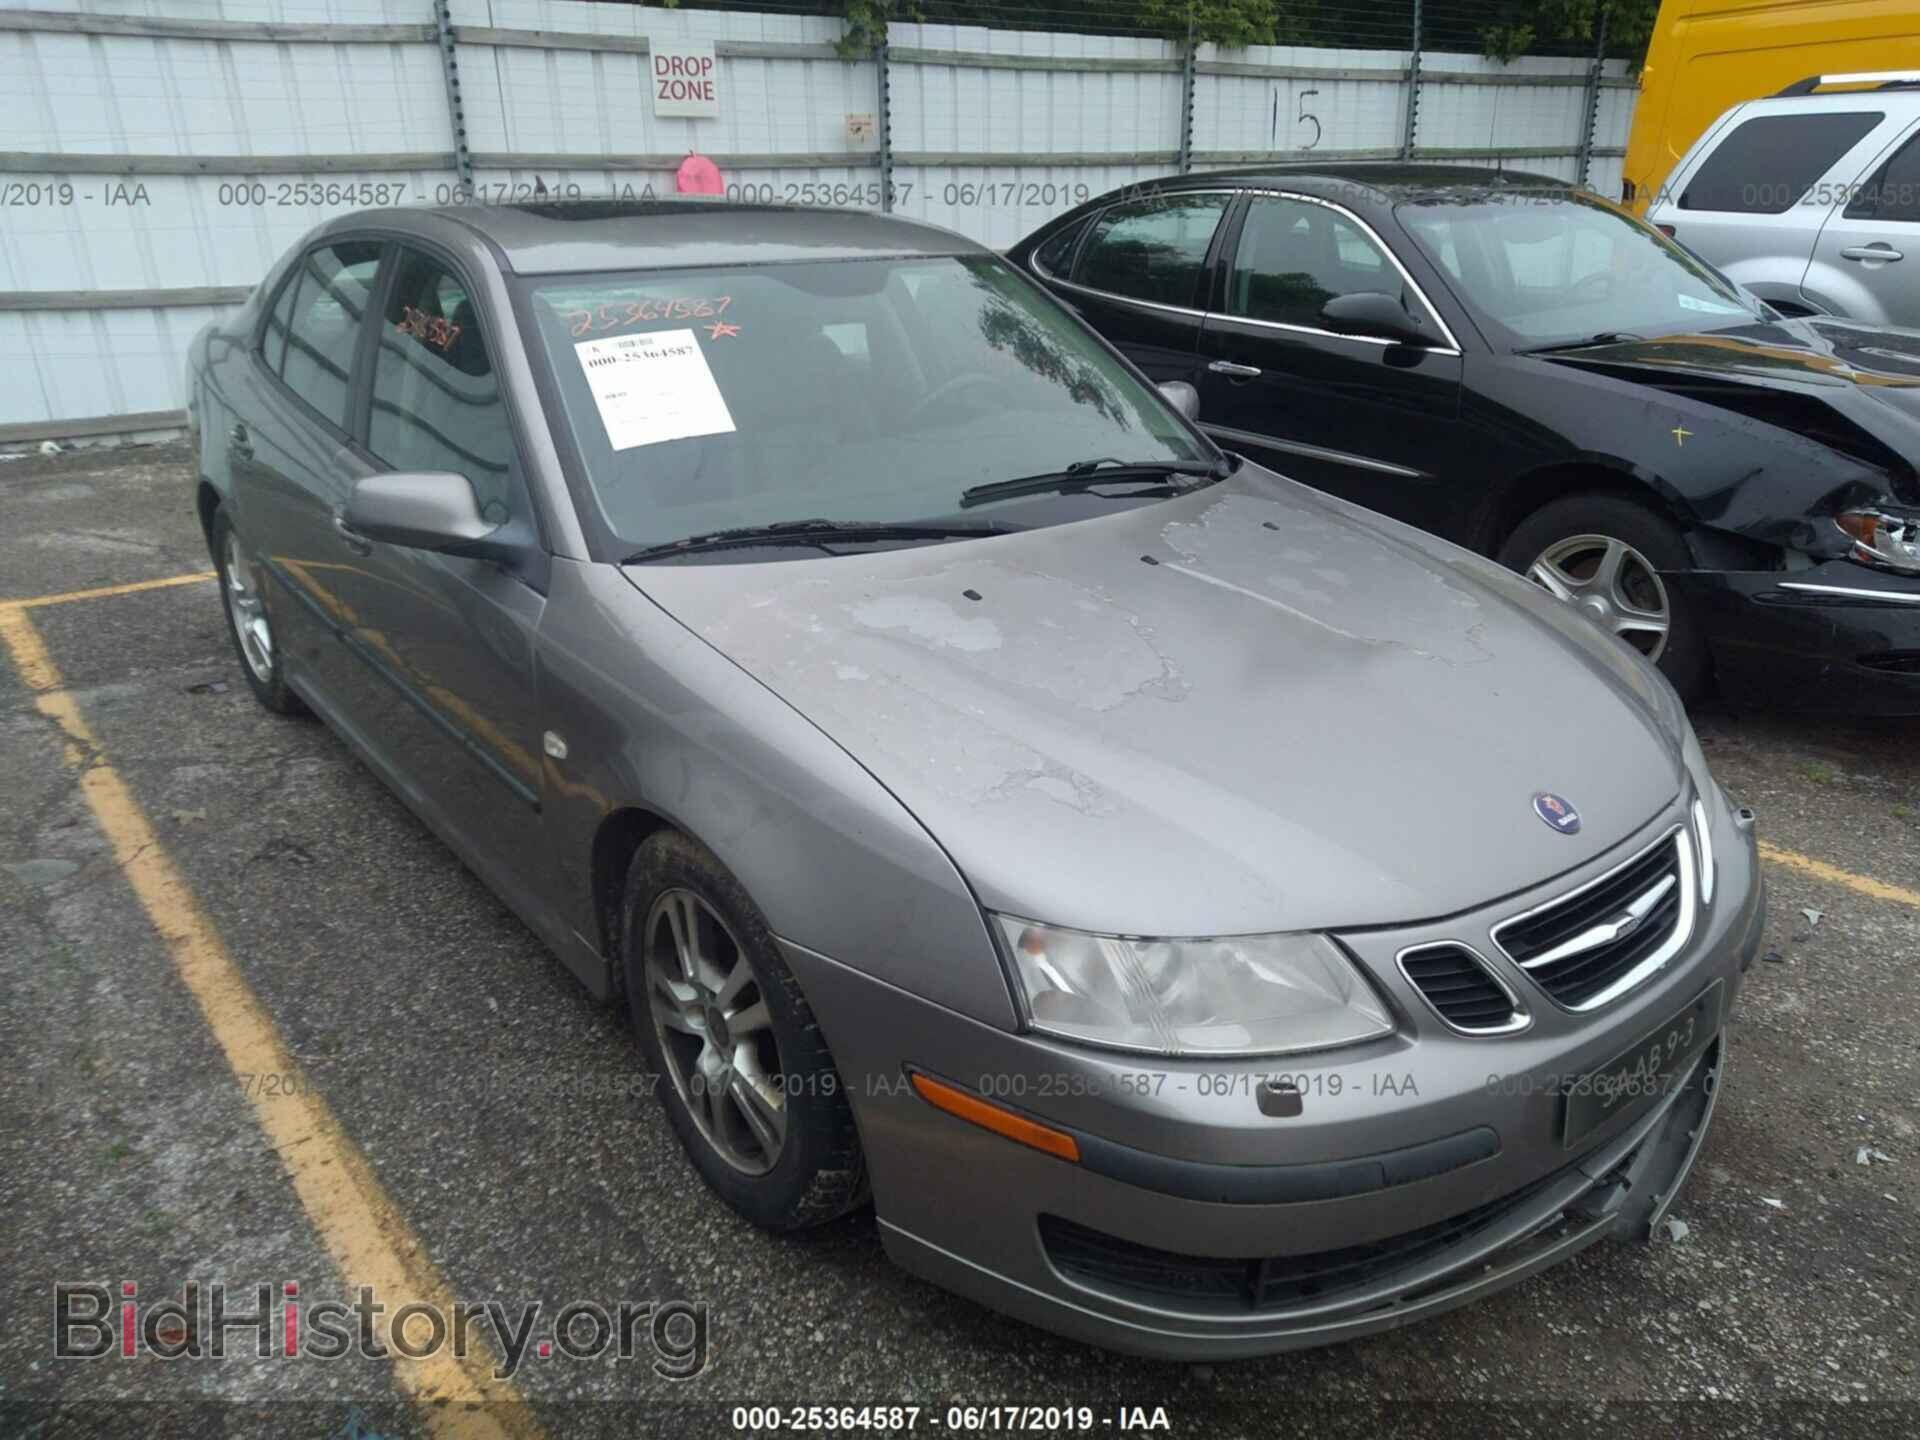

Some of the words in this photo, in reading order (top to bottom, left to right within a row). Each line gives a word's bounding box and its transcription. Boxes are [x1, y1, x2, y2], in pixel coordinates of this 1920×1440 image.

[655, 55, 713, 76] DROP
[657, 79, 715, 101] ZONE
[1272, 87, 1321, 151] 15
[567, 296, 731, 337] 25364587
